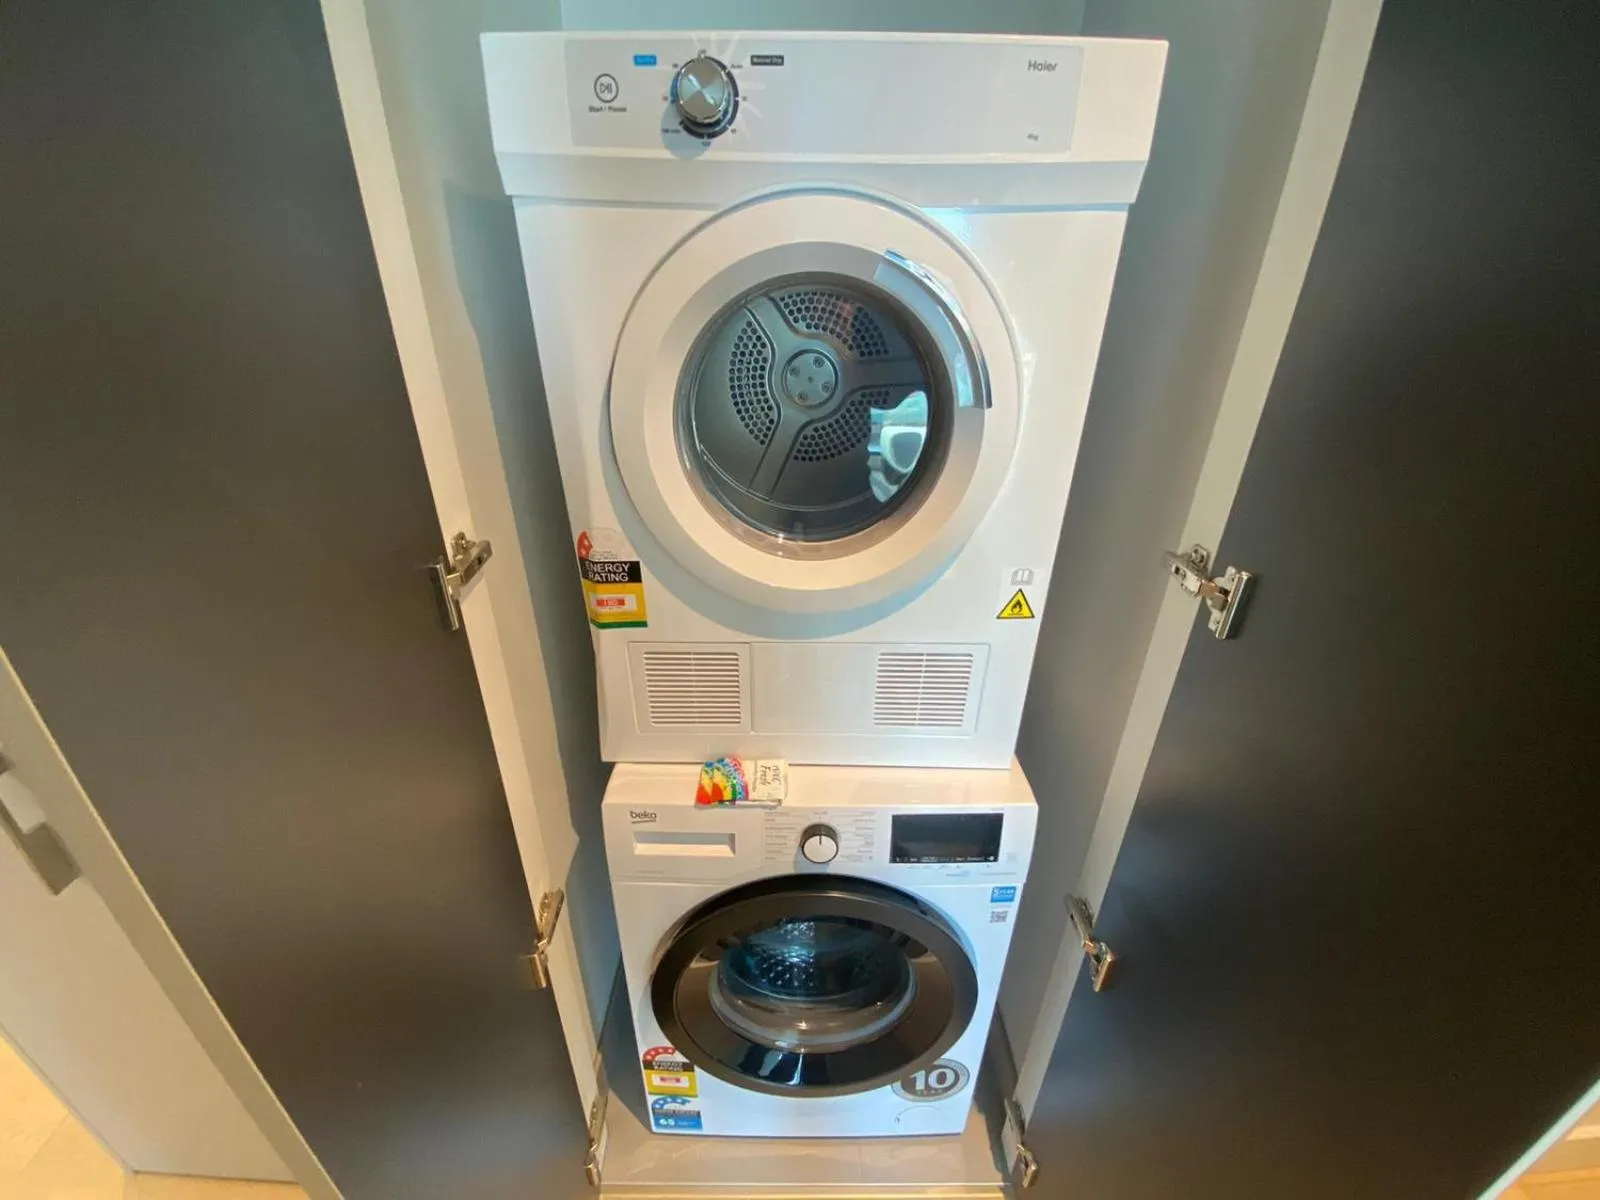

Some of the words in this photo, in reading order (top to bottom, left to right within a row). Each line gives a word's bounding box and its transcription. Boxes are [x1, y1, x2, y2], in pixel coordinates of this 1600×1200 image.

[1027, 60, 1058, 72] Haier
[585, 561, 630, 573] ENERGY
[588, 572, 629, 582] RATING
[630, 810, 657, 819] beko
[909, 1068, 955, 1090] 10
